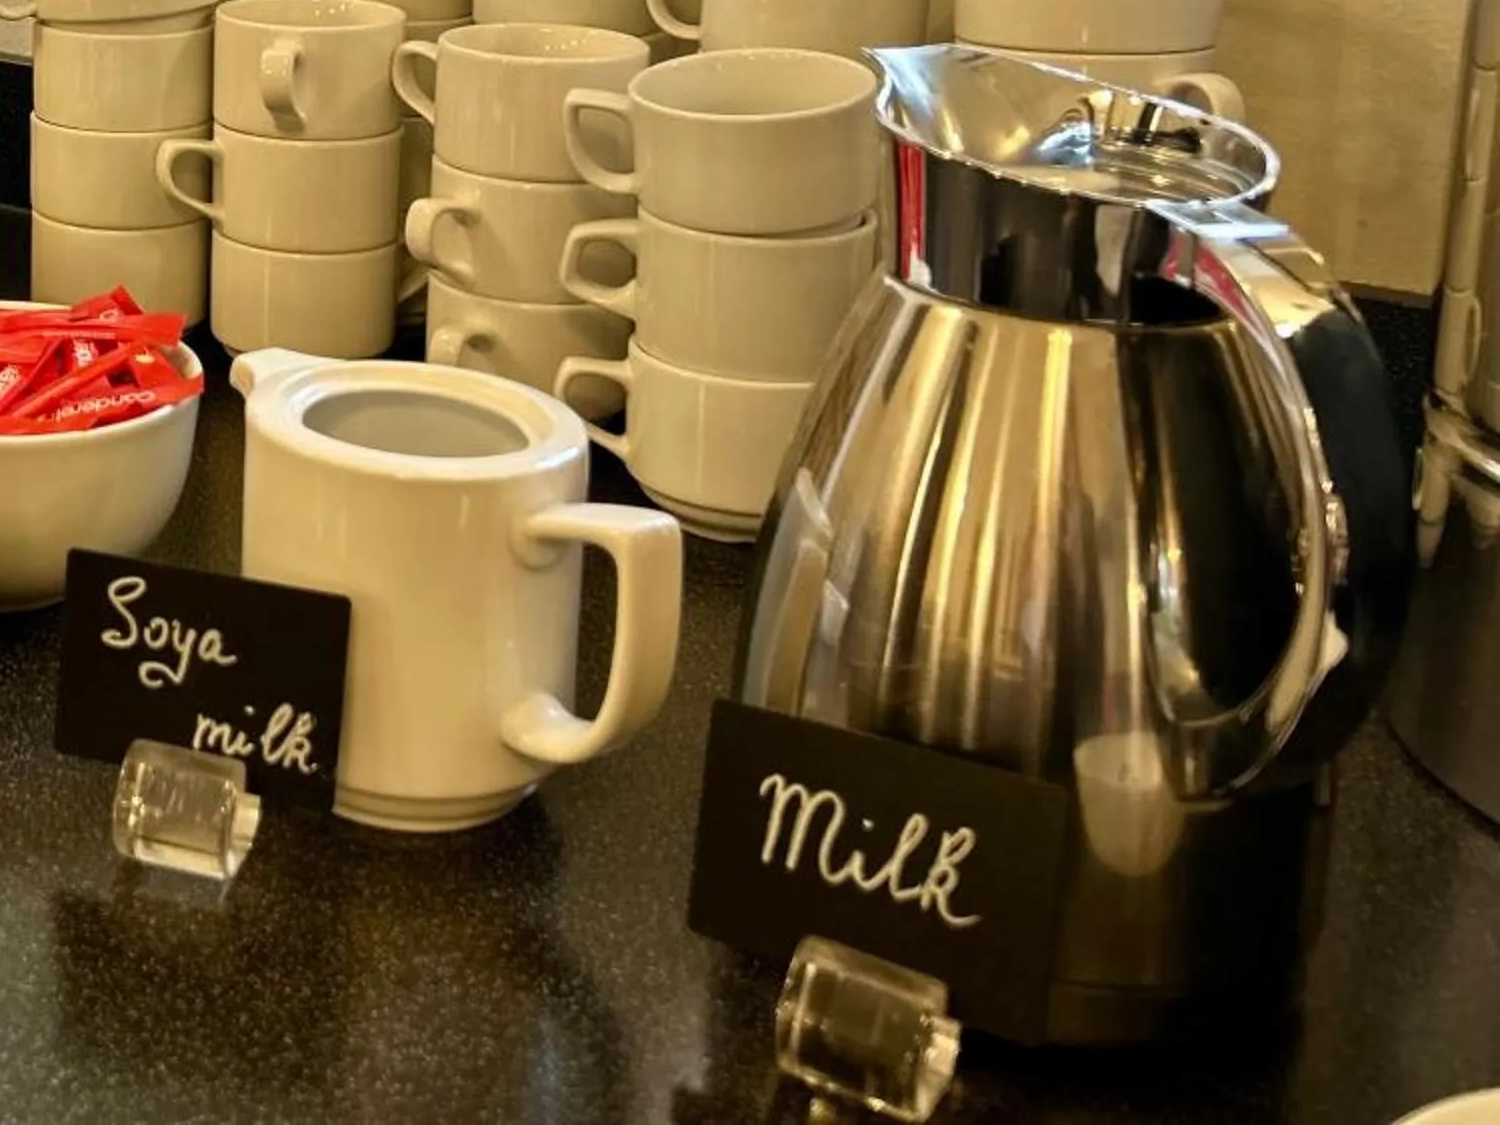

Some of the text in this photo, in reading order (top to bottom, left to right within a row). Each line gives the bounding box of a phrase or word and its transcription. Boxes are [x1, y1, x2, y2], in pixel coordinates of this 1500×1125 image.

[102, 576, 237, 688] Soya
[192, 702, 318, 774] milk
[758, 772, 983, 928] Milk
